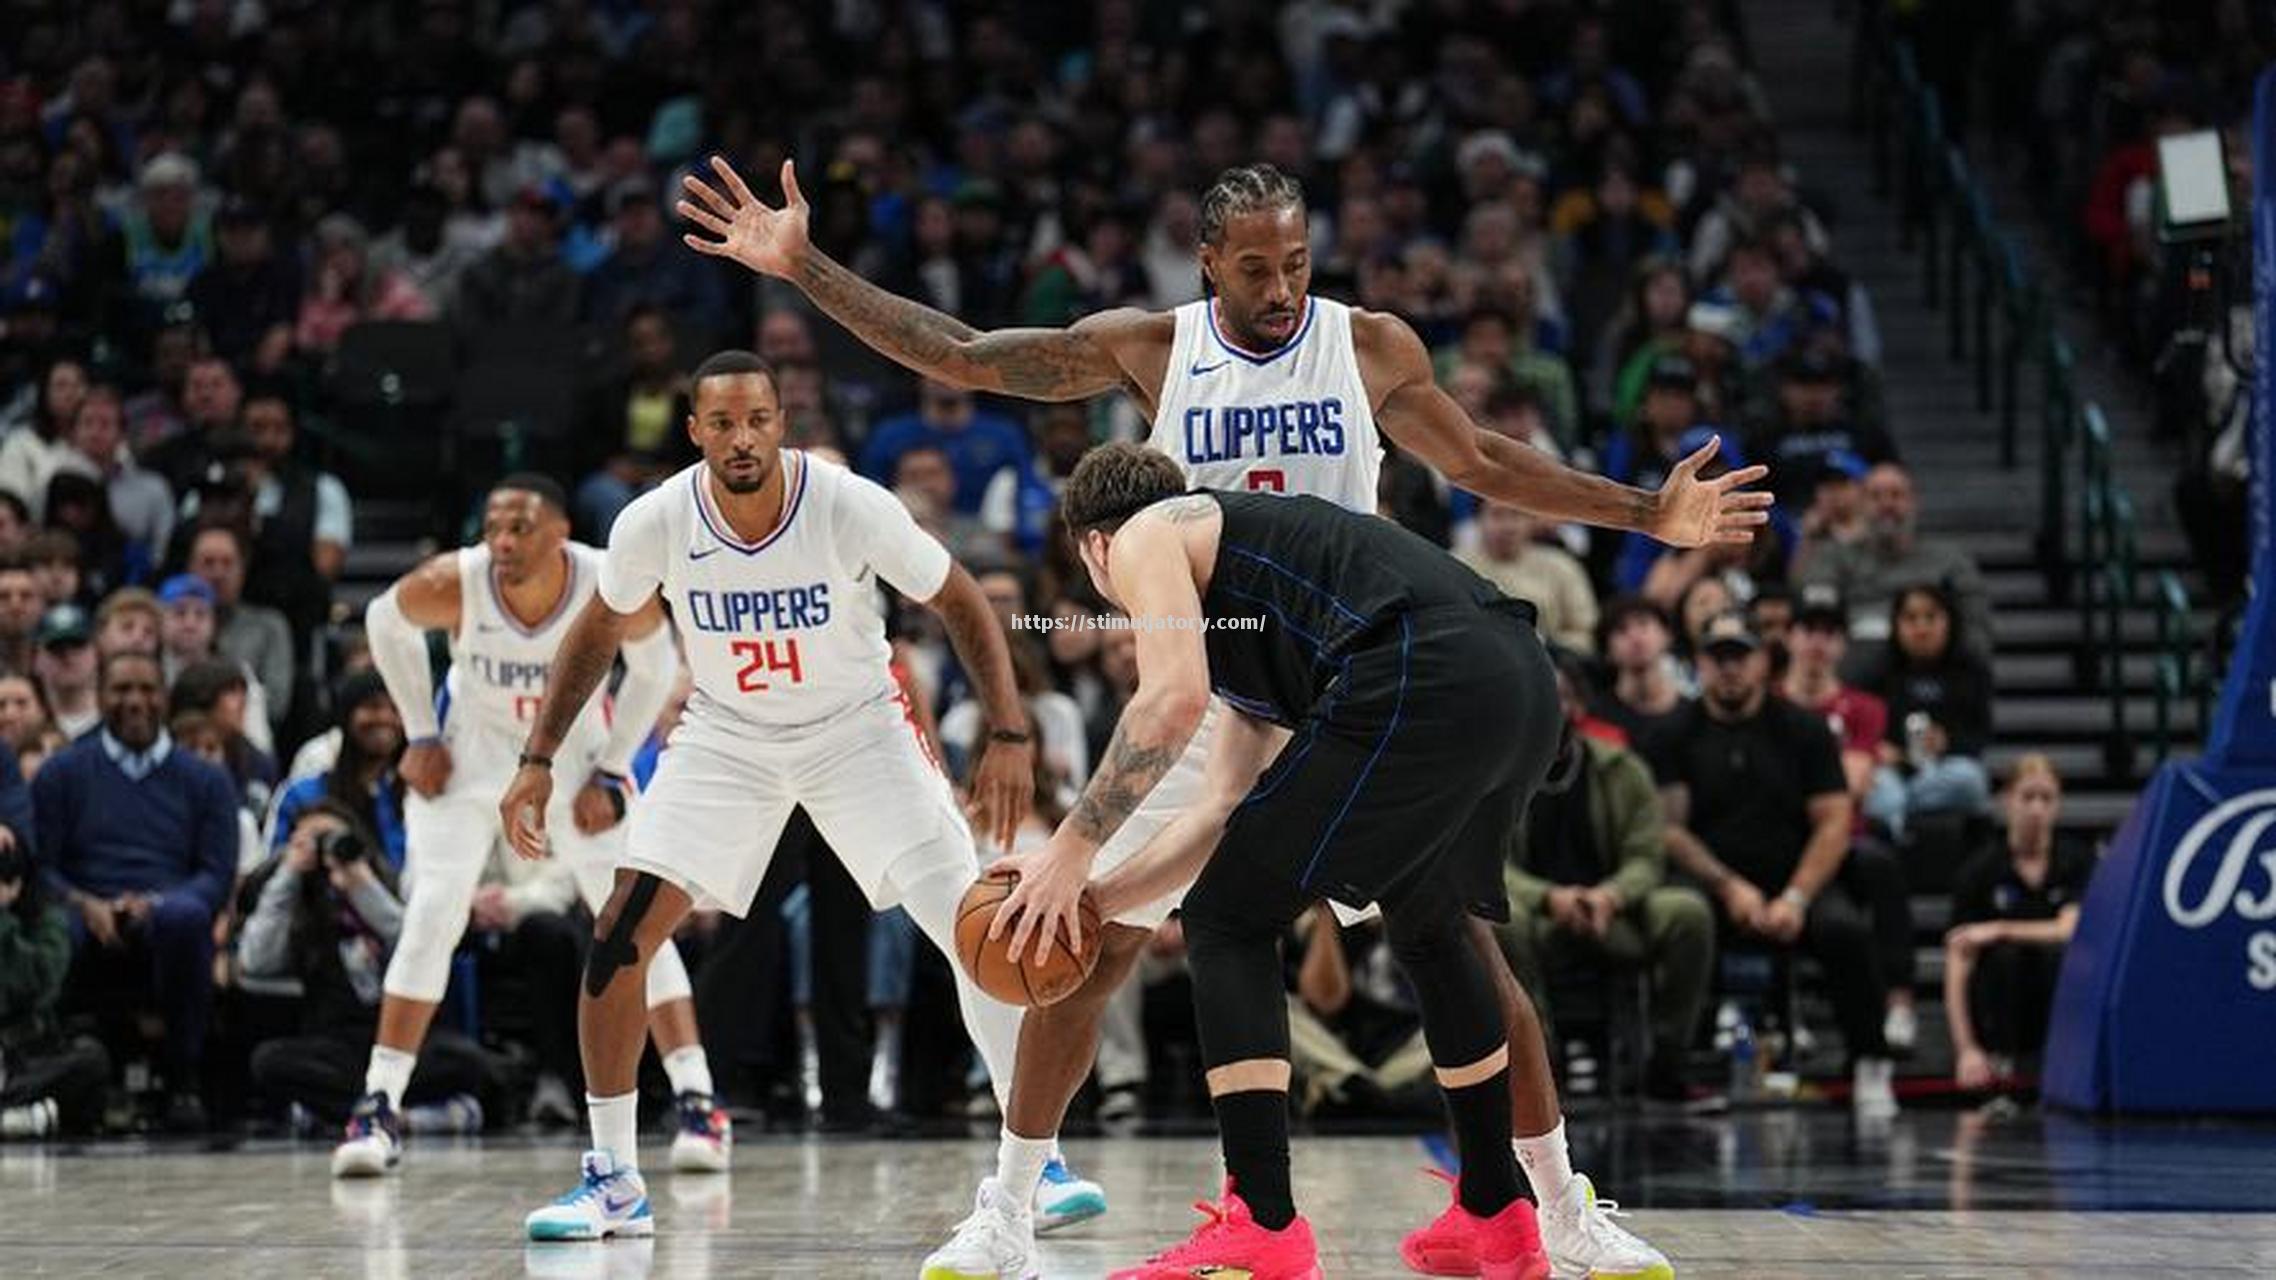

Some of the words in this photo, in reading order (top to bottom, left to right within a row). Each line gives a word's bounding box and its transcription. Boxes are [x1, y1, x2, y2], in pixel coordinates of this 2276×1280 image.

[1184, 397, 1346, 464] CLIPPERS
[688, 582, 830, 632] CLIPPERS
[731, 638, 803, 693] 24
